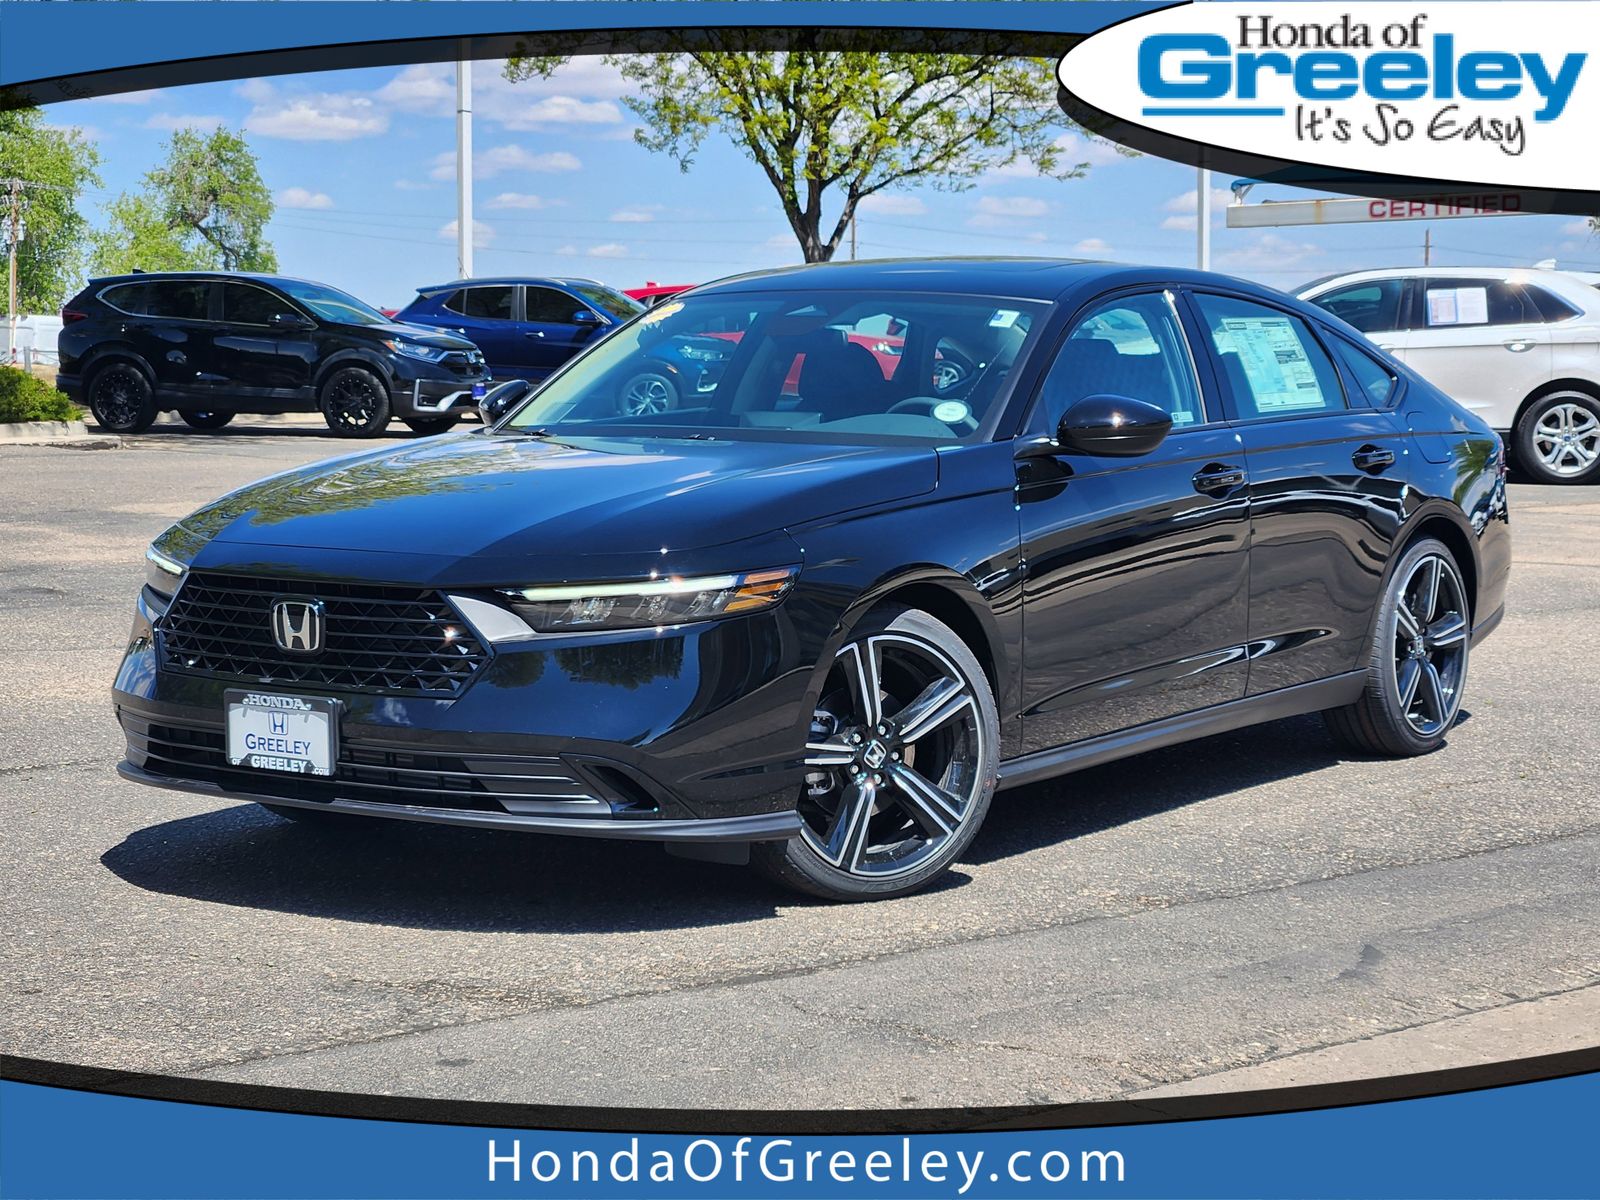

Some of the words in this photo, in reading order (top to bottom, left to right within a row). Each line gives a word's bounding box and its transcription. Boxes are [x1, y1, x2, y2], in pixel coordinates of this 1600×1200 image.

[1368, 193, 1521, 218] CERTIFIED
[246, 693, 307, 711] HONDA
[245, 733, 311, 756] GREELEY
[250, 755, 308, 774] GREELEY
